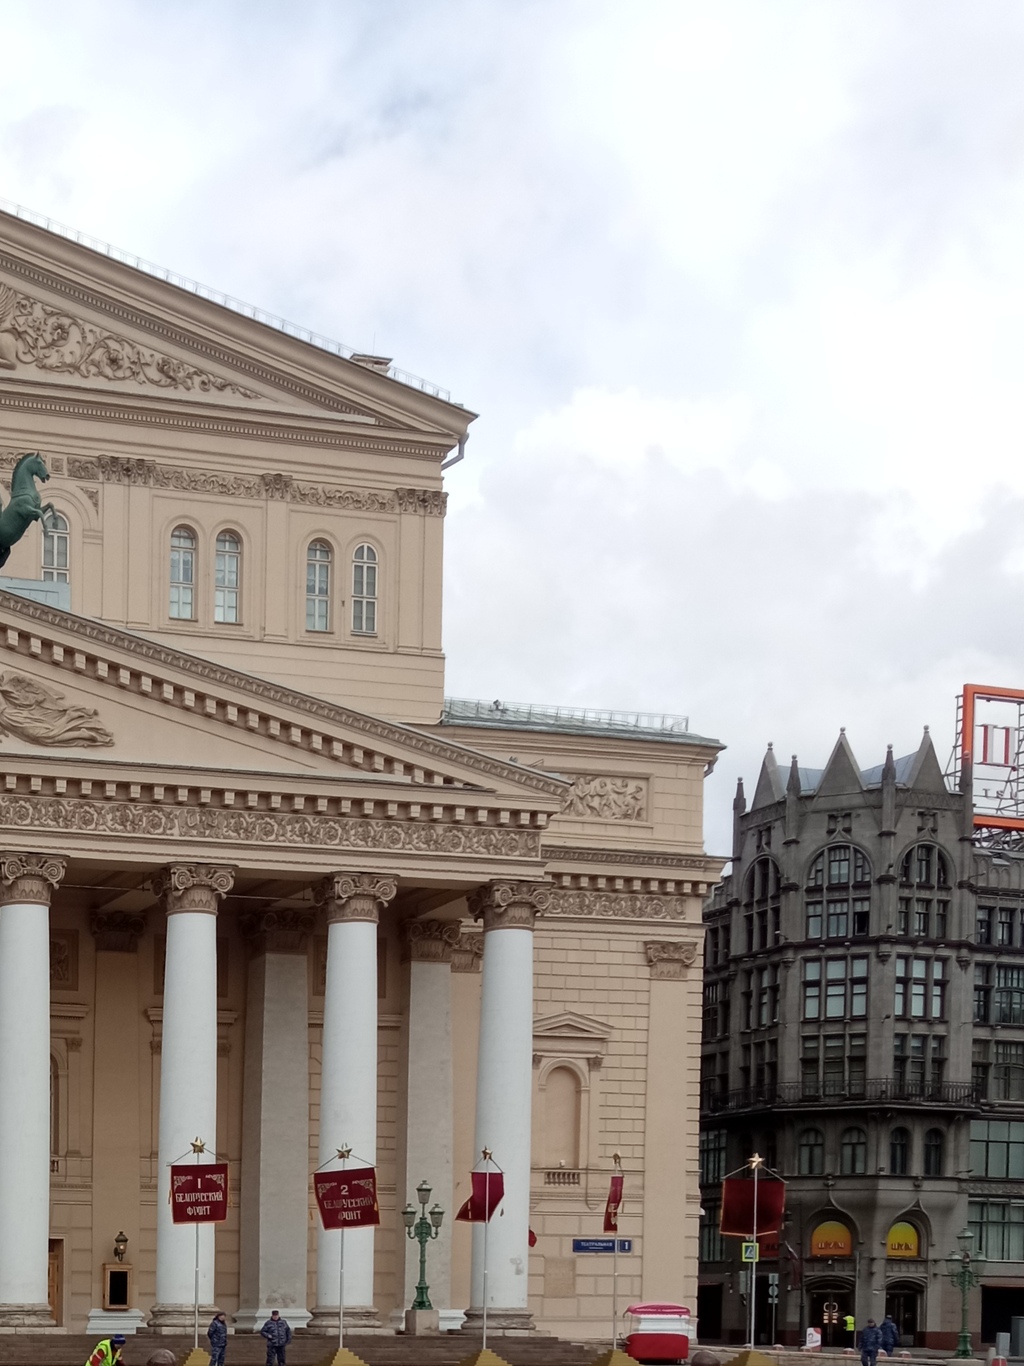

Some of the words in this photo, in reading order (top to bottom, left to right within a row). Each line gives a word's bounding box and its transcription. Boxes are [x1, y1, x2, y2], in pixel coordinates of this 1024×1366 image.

[340, 1184, 349, 1195] 2
[175, 1190, 224, 1203] БЕЛОРУССКИЙ
[186, 1205, 211, 1216] ФРОНТ
[624, 1241, 629, 1250] 1
